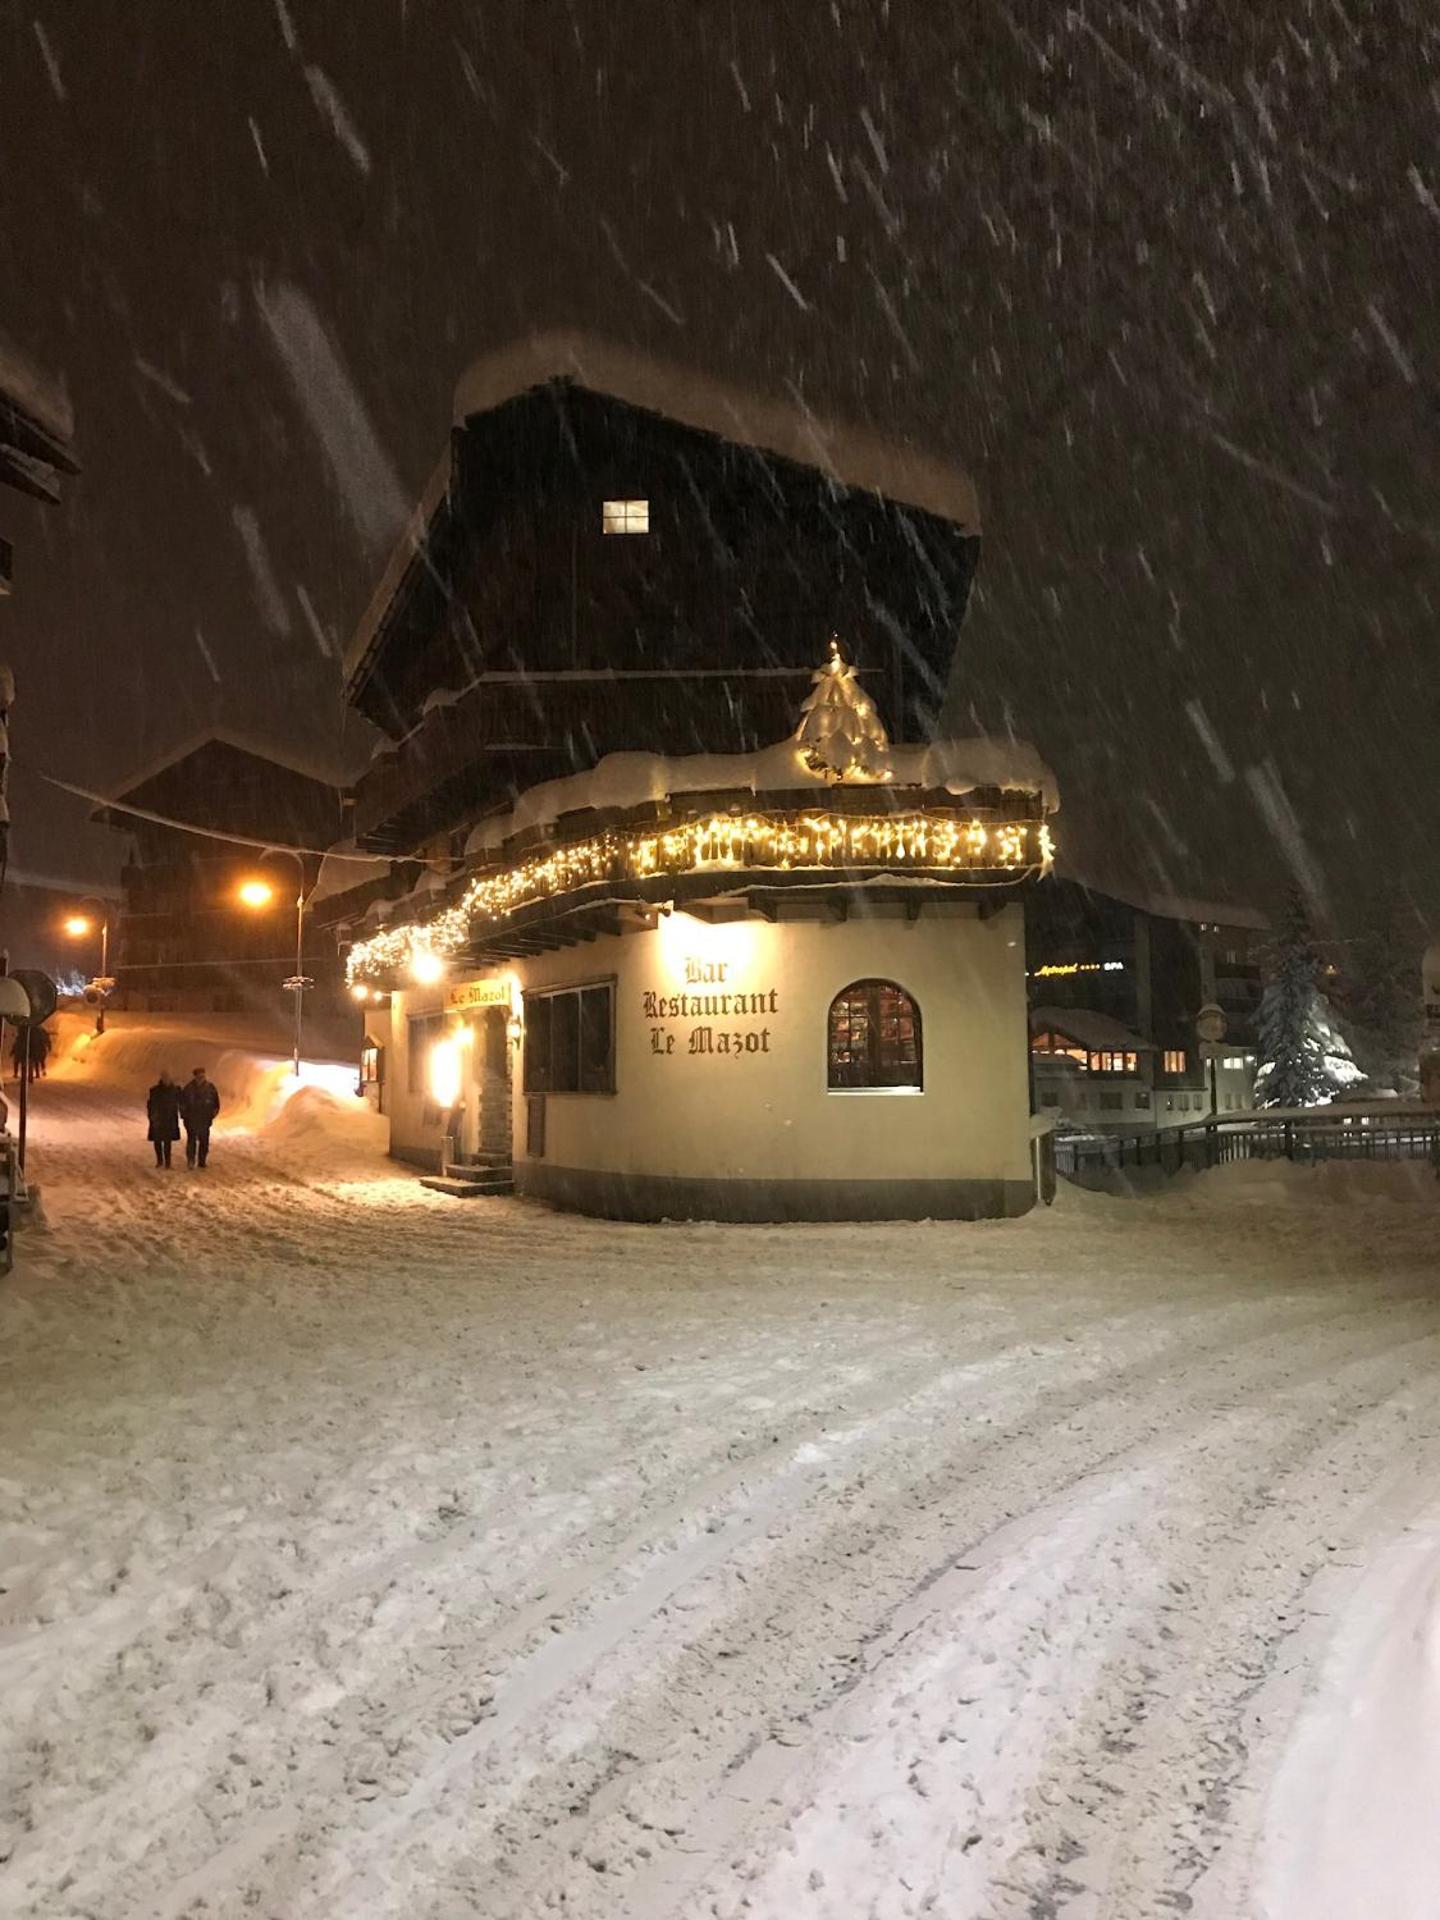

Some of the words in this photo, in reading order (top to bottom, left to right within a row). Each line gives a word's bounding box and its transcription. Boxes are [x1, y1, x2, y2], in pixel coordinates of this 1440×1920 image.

[684, 956, 729, 985] Bar
[450, 988, 465, 1004] Le
[643, 988, 779, 1019] Restaurant
[650, 1027, 676, 1055] Le
[688, 1026, 771, 1059] Mazot
